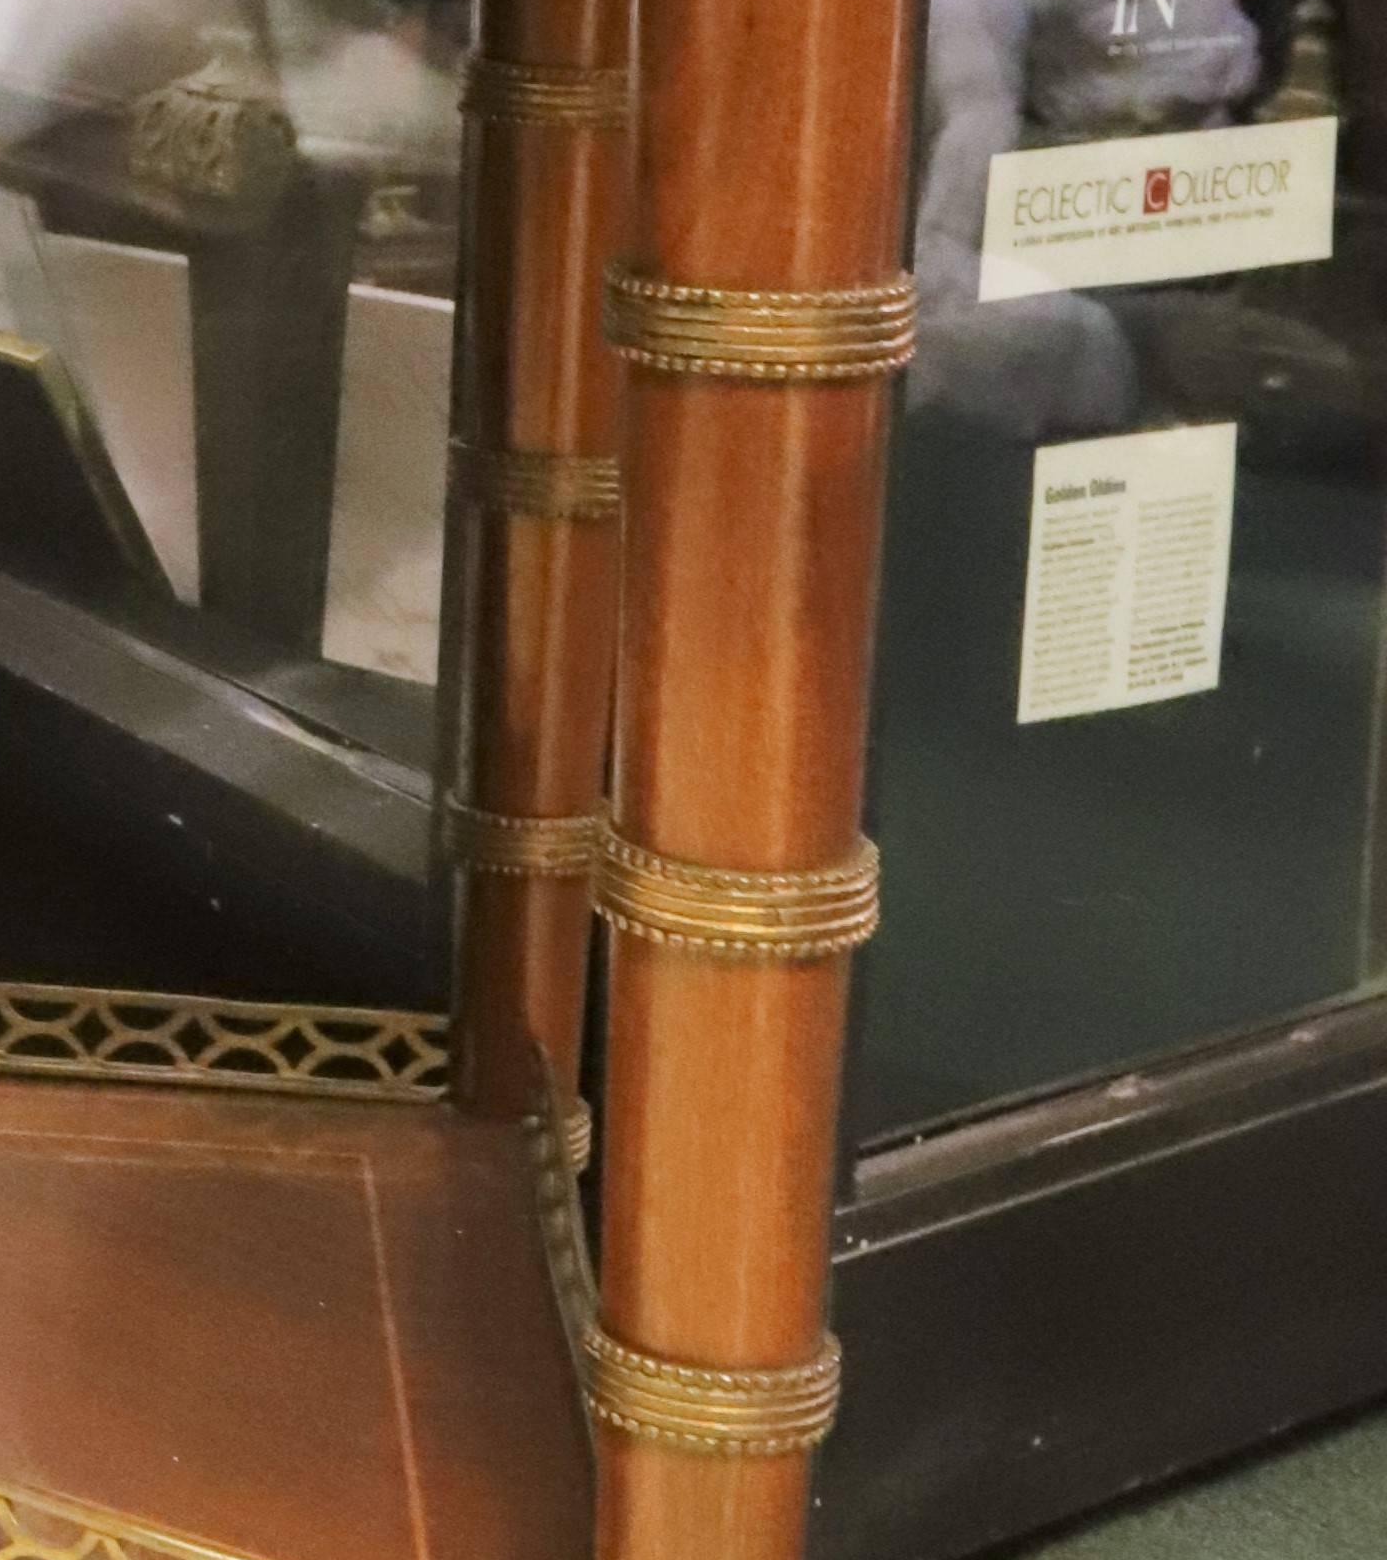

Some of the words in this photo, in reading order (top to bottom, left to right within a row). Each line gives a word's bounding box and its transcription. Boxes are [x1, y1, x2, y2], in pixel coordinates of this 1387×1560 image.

[1013, 176, 1132, 226] ECLECTIC
[1145, 159, 1291, 212] COLLECTOR
[1045, 483, 1087, 505] Golden
[1089, 476, 1127, 498] Oldies
